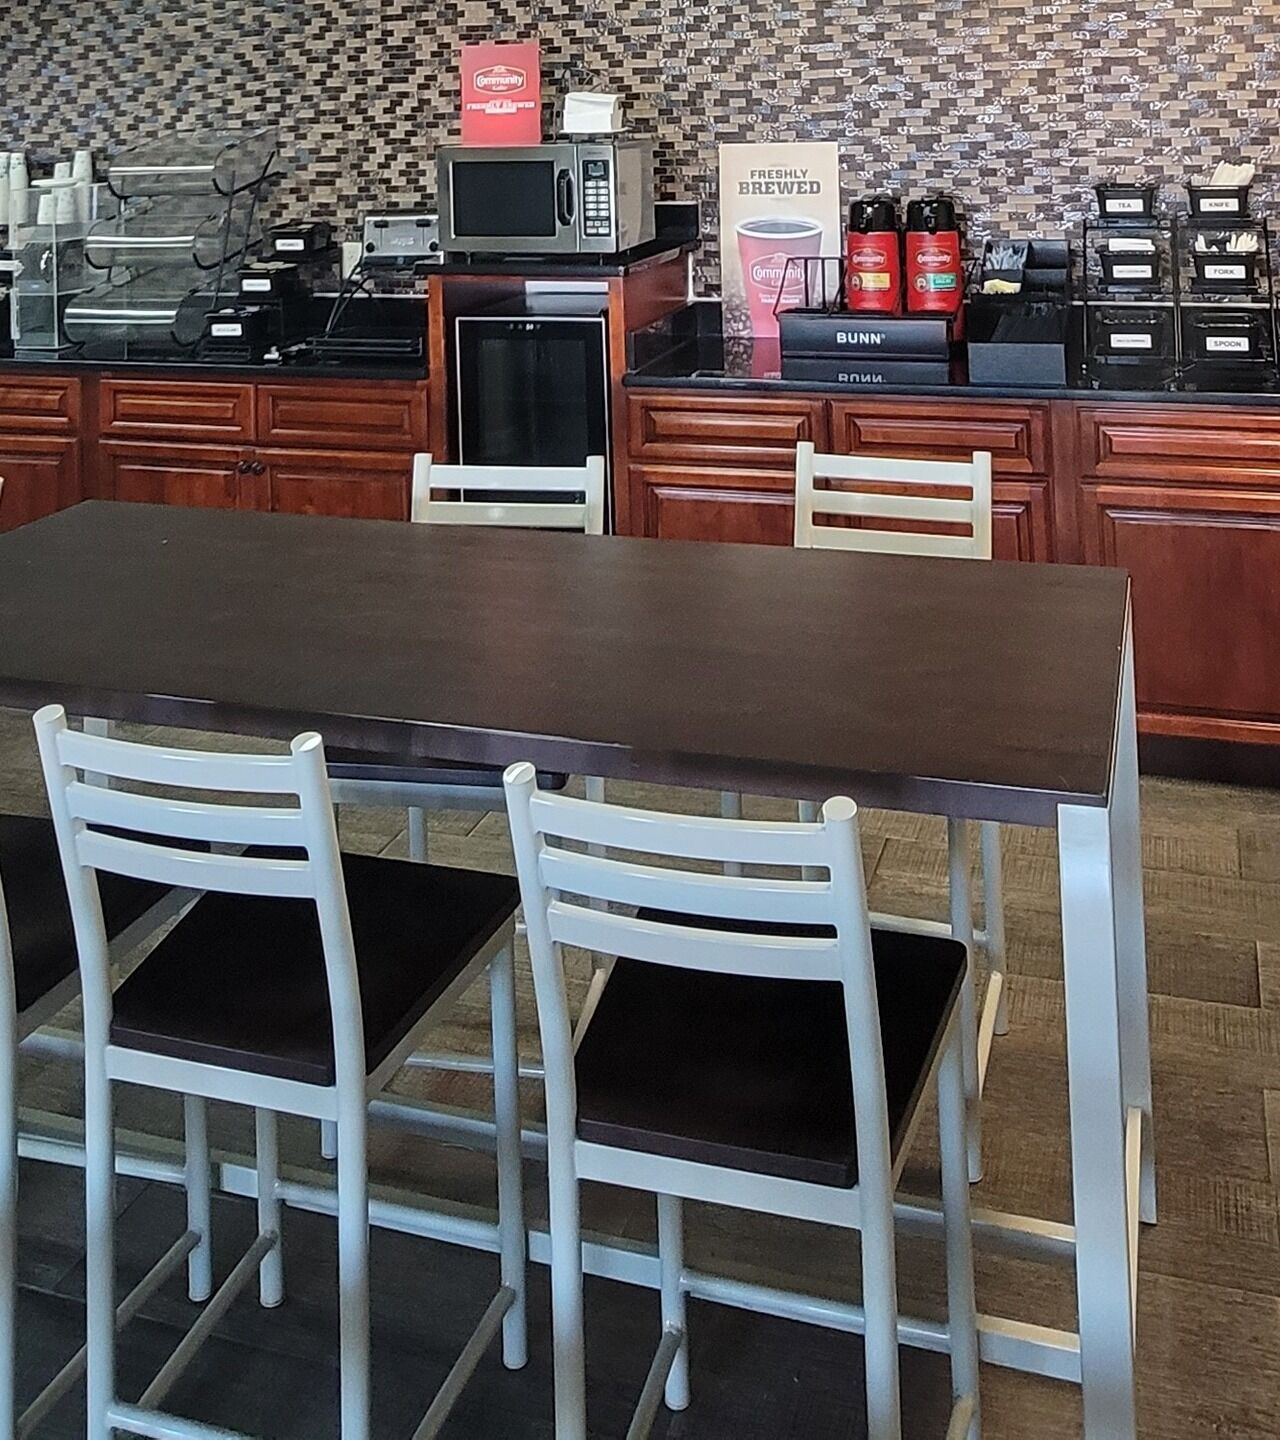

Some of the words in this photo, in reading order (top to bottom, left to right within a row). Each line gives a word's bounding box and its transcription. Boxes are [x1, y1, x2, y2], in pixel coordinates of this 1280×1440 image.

[476, 74, 524, 88] Community
[750, 169, 808, 180] FRESHLY
[738, 180, 821, 195] BREWED
[753, 265, 805, 281] Commnity
[836, 332, 881, 345] BUNN
